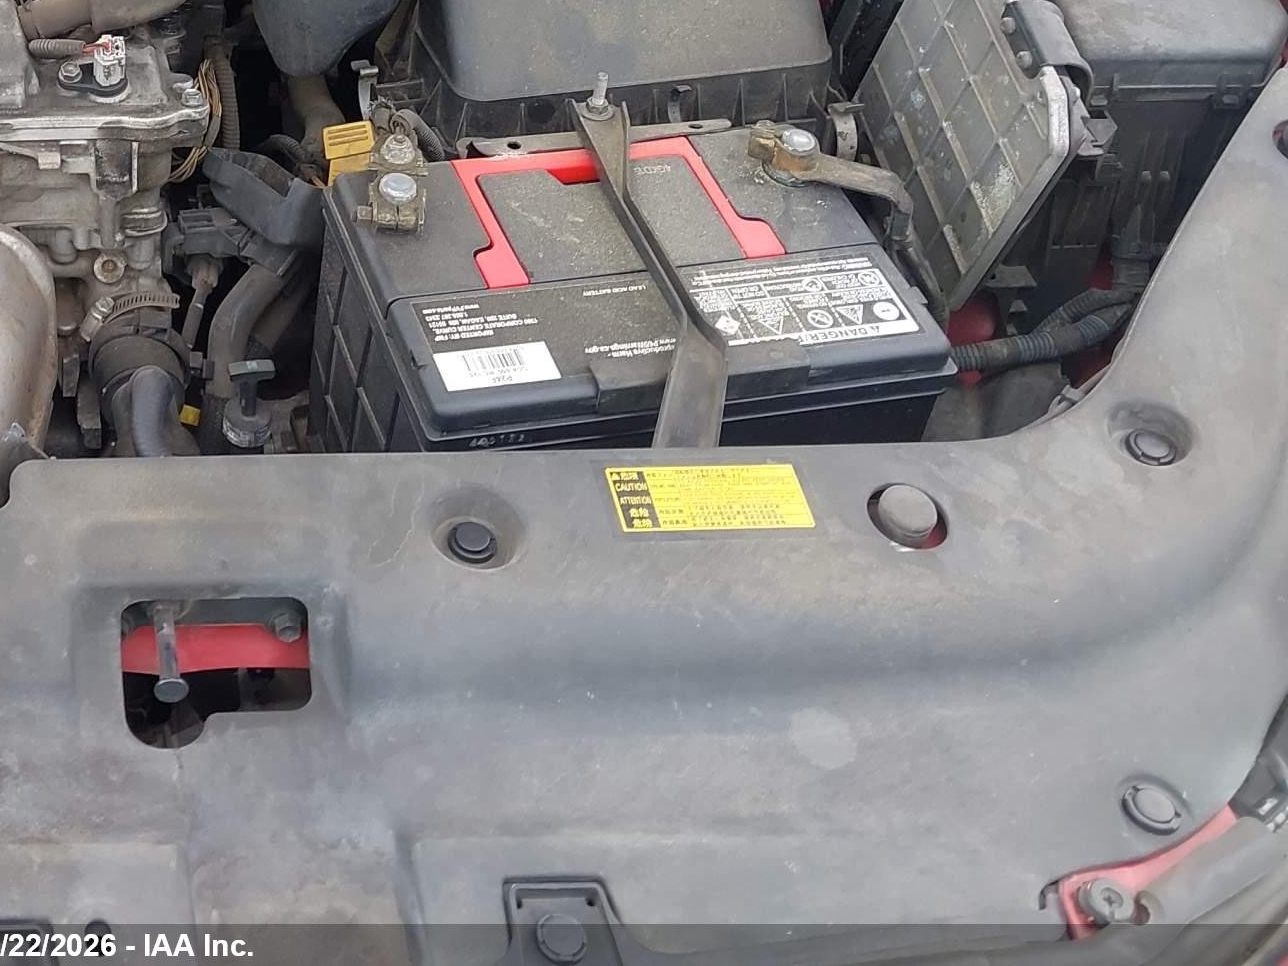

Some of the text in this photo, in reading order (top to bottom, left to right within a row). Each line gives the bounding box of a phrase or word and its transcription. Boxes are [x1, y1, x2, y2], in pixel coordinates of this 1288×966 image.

[457, 323, 483, 331] CENTER
[483, 319, 524, 328] CORPORATE
[615, 482, 647, 492] CAUTION
[620, 496, 652, 505] ATTENTION
